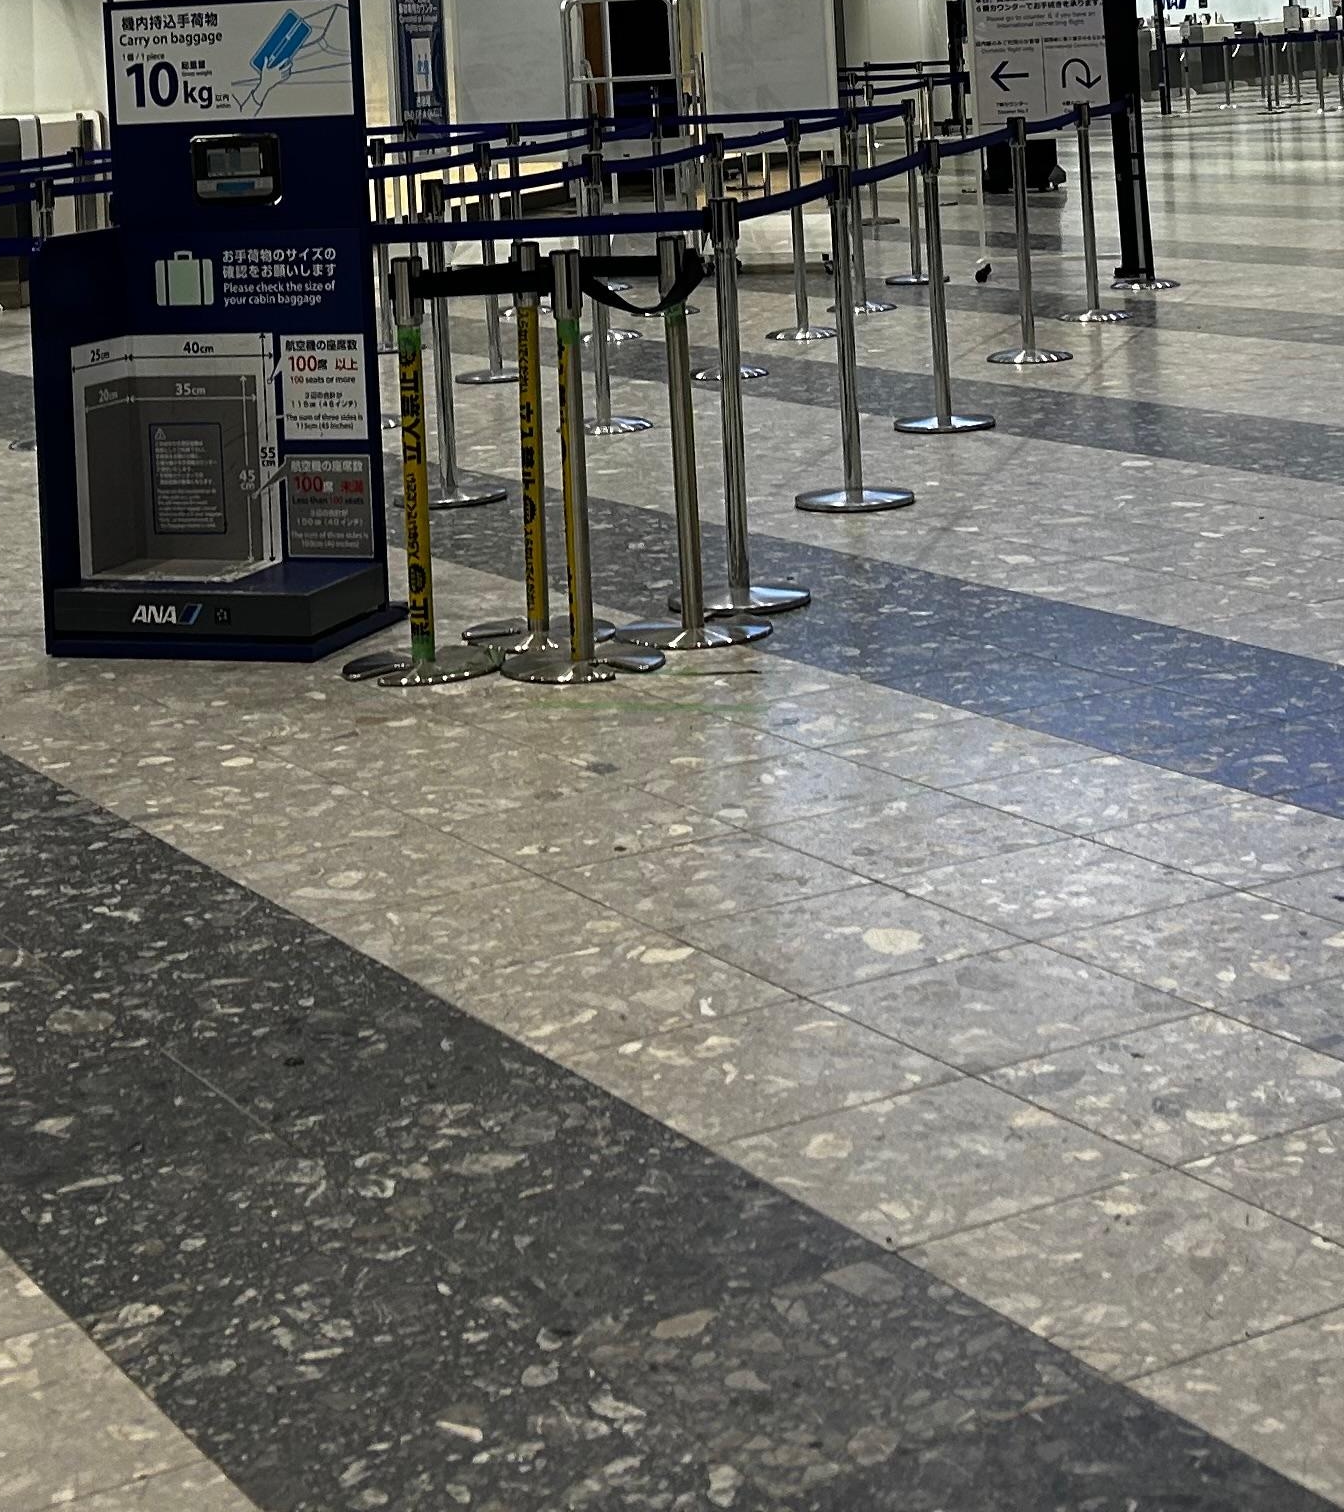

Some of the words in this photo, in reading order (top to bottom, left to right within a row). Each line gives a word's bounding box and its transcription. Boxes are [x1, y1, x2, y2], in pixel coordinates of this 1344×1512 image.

[121, 12, 217, 31] 機内持込手荷物
[119, 34, 150, 48] Carry
[153, 35, 168, 44] on
[171, 32, 223, 46] baggage
[147, 53, 164, 62] piece
[126, 61, 179, 108] 10
[182, 80, 213, 109] kg
[222, 247, 336, 263] お手荷物のサイズの
[222, 263, 336, 279] 確認をお願いします
[223, 282, 255, 293] Please
[256, 281, 284, 292] check
[286, 281, 302, 292] the
[305, 280, 323, 291] size
[325, 279, 335, 291] of
[224, 296, 247, 307] your
[248, 294, 276, 305] cabin
[277, 293, 322, 306] baggage
[183, 341, 214, 354] 40cm
[285, 339, 357, 352] 航空機の座席数
[90, 349, 110, 362] 25cm
[288, 355, 327, 372] 100席
[335, 357, 358, 371] 以上
[290, 376, 304, 384] 100
[305, 376, 324, 384] seats
[336, 376, 355, 384] more
[175, 382, 205, 395] 35cm
[98, 389, 118, 402] 20cm
[260, 446, 276, 459] 55
[261, 459, 276, 467] cm
[239, 469, 256, 481] 45
[240, 481, 256, 489] cm
[294, 475, 334, 493] 100席
[131, 604, 177, 624] ANA
